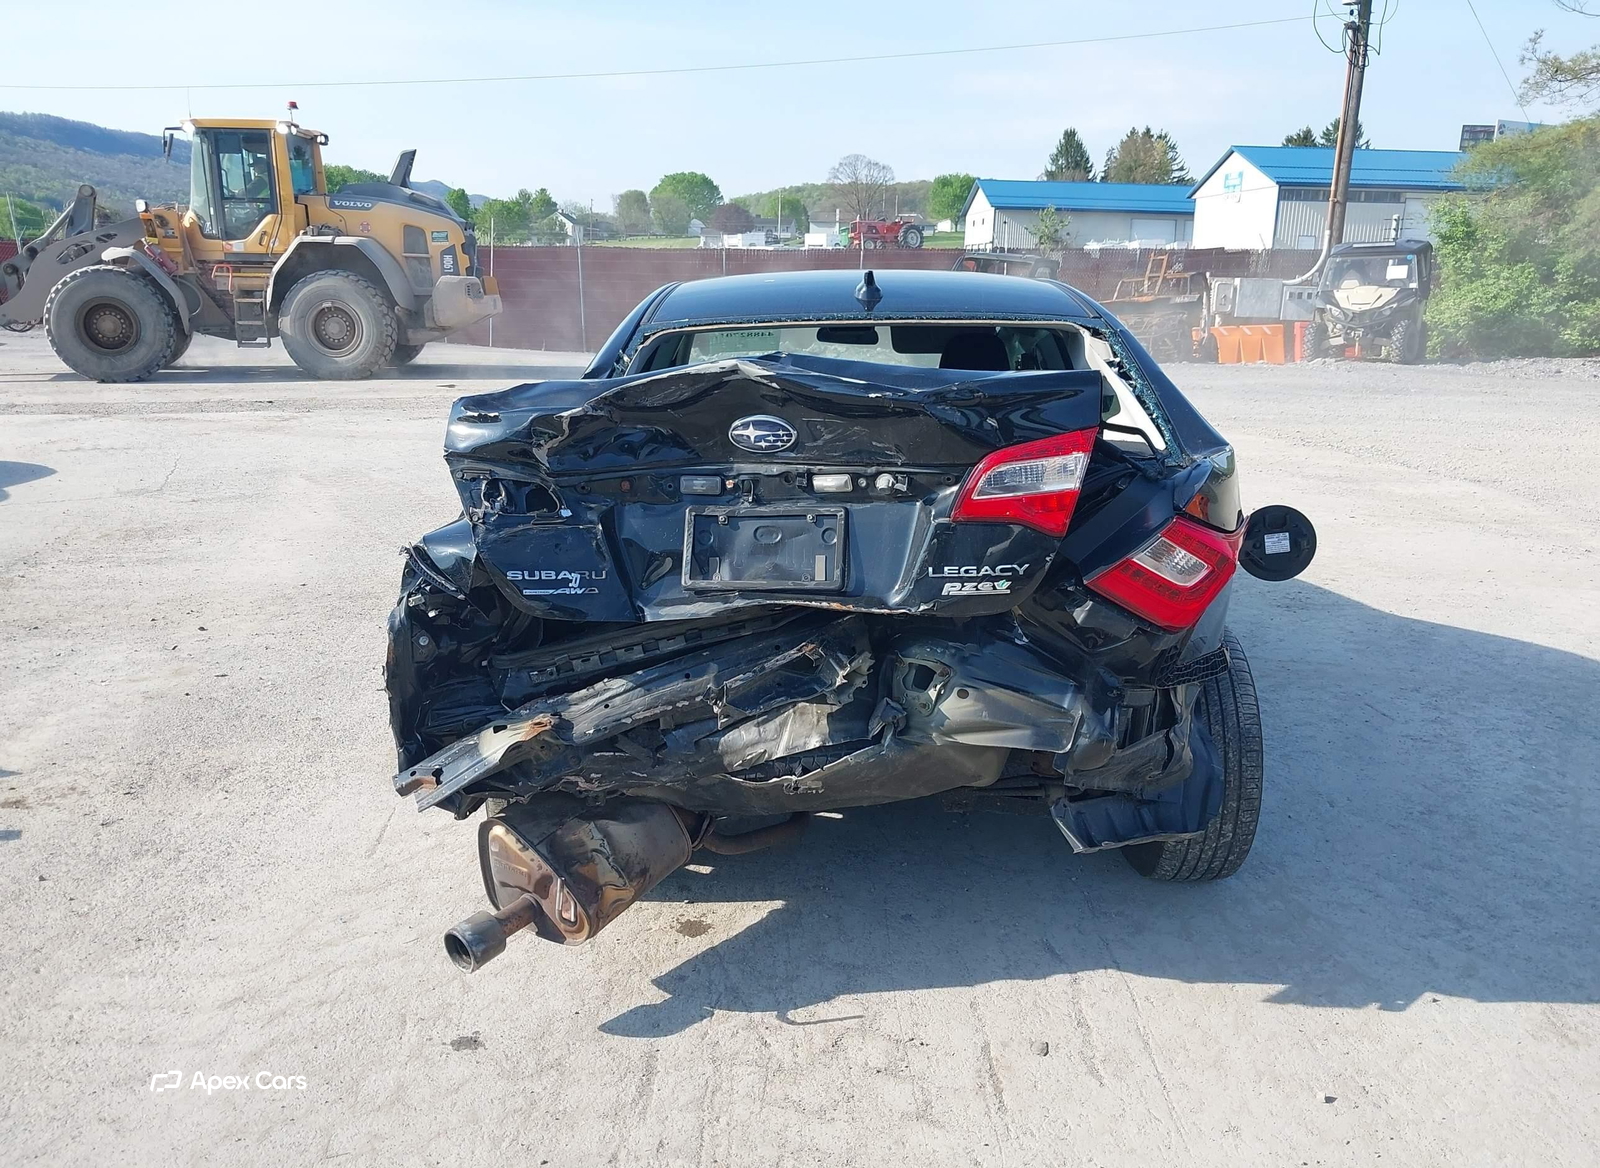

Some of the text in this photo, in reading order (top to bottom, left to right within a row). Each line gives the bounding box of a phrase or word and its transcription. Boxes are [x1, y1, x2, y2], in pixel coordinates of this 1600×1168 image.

[333, 200, 372, 208] VOLVO
[443, 254, 454, 273] L90H
[506, 570, 607, 581] SUBARU
[928, 563, 1030, 578] LEGACY
[553, 587, 599, 595] AWD
